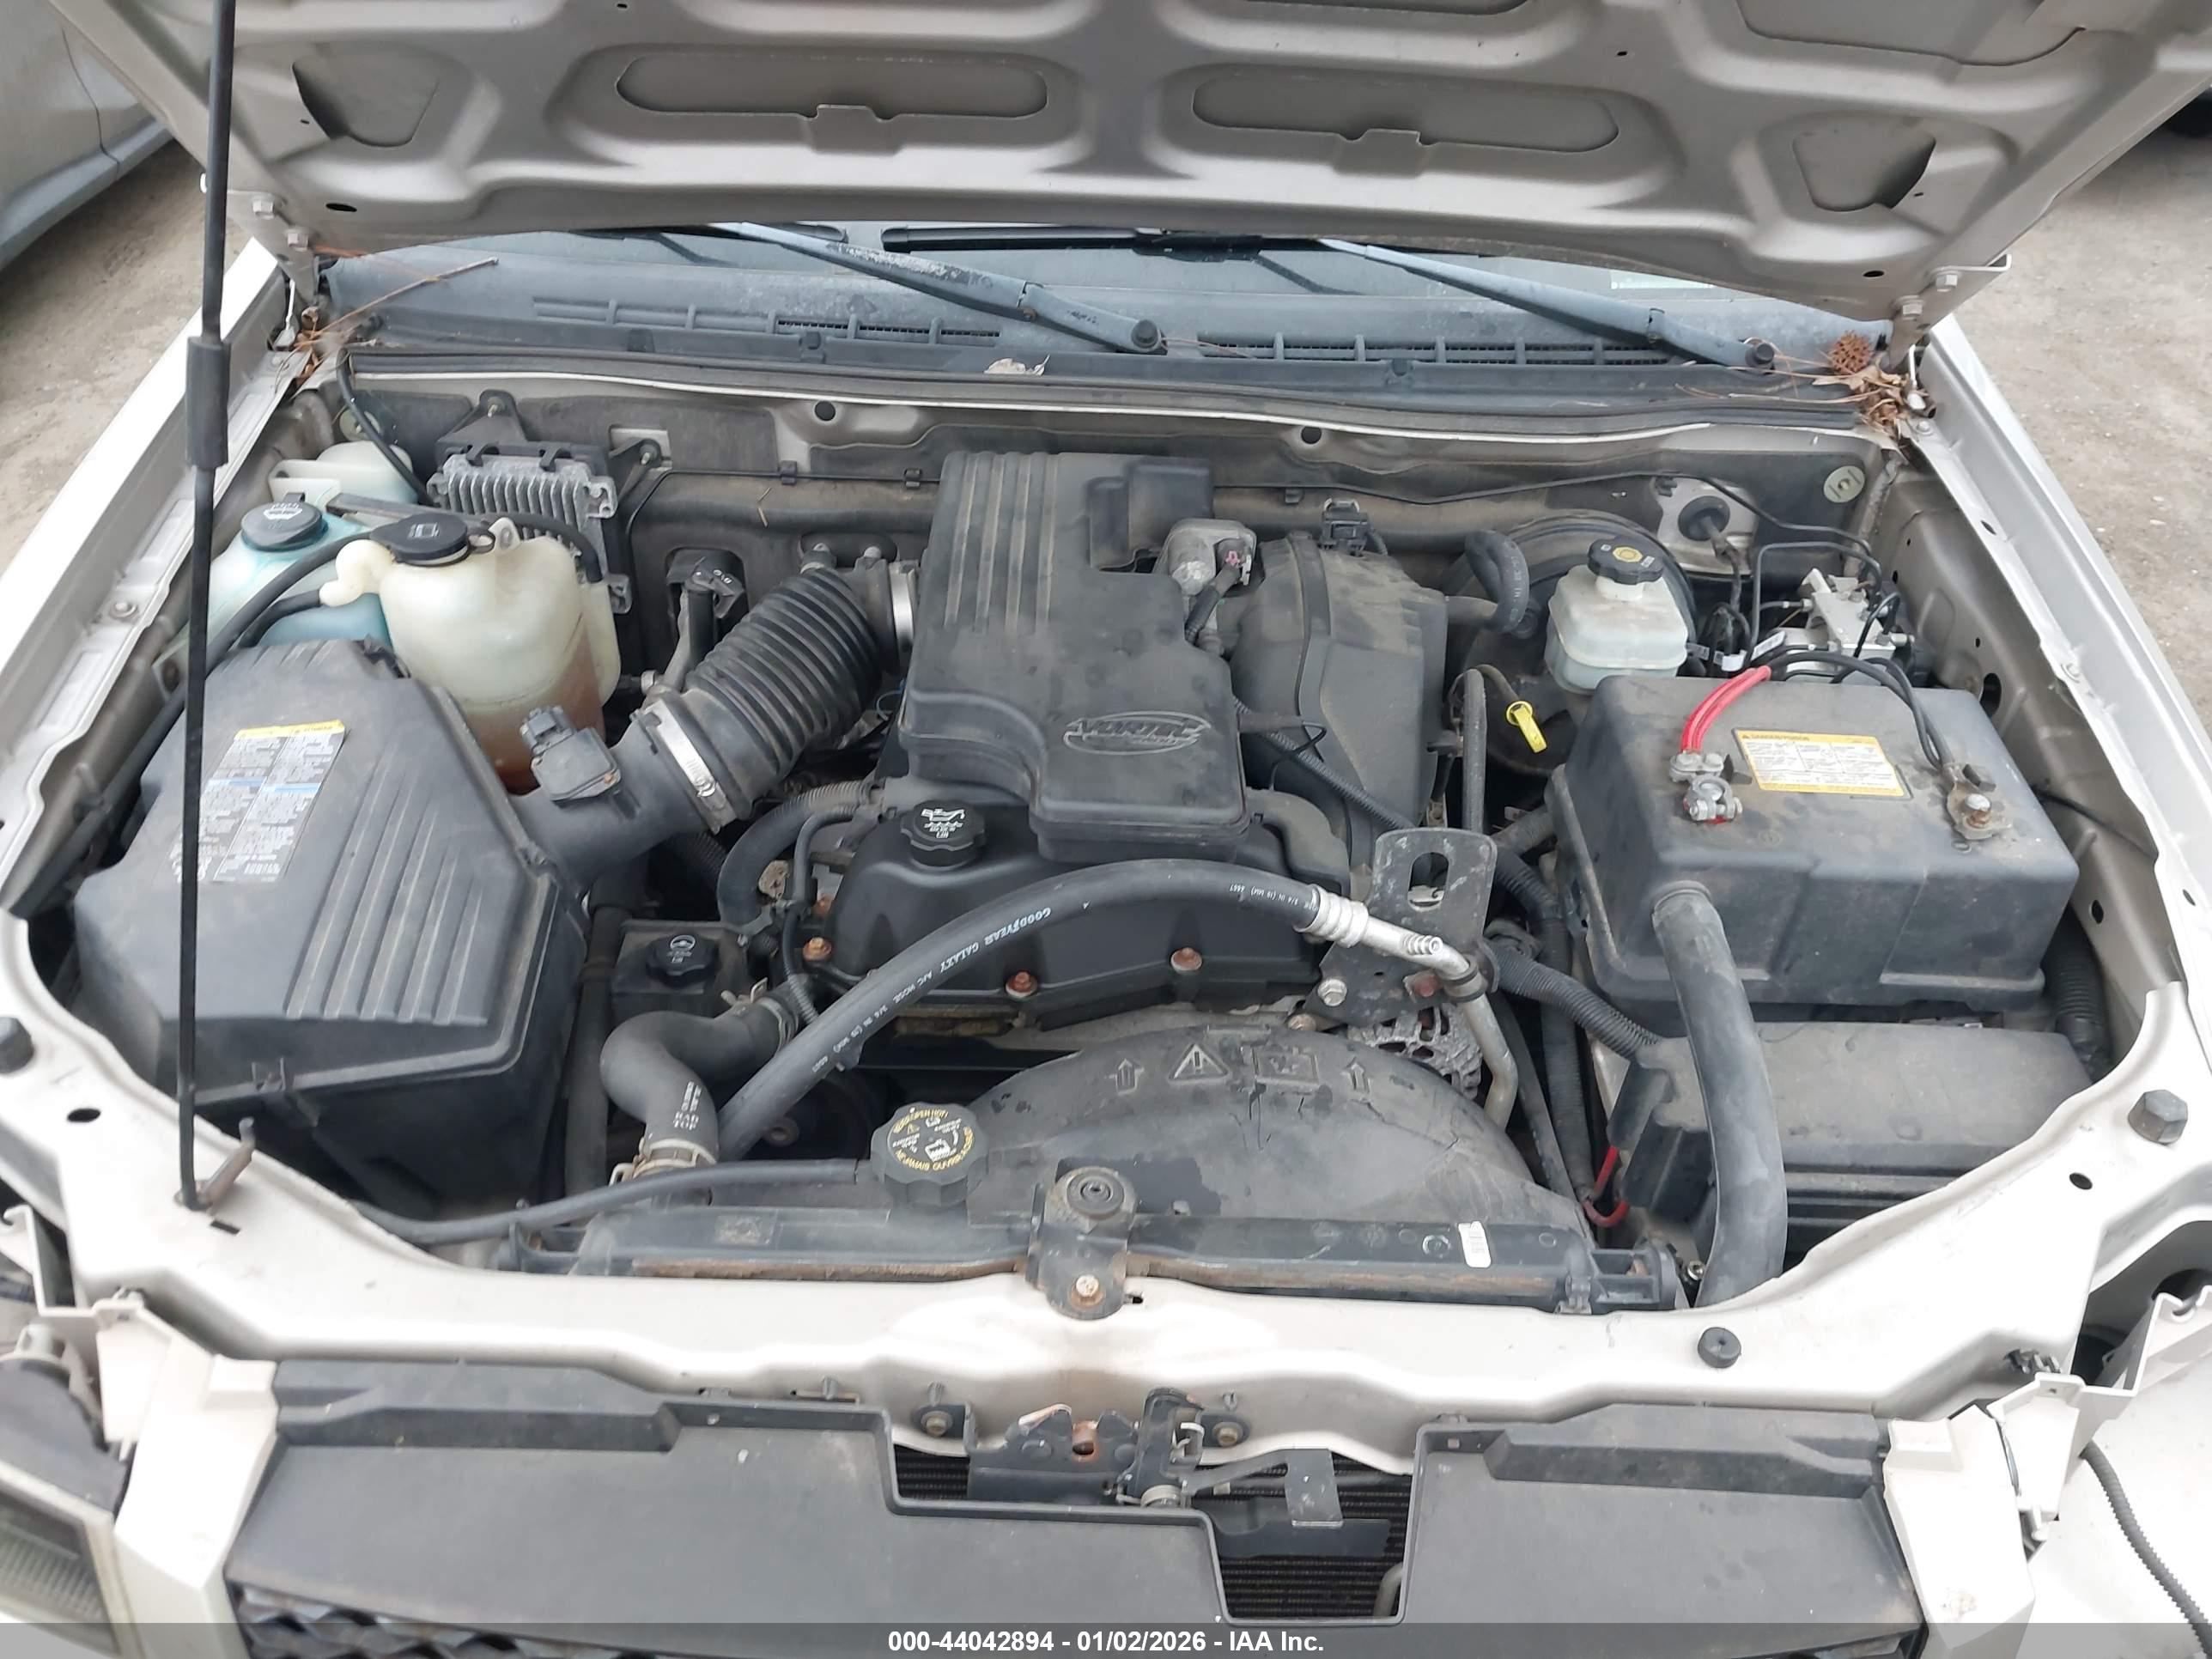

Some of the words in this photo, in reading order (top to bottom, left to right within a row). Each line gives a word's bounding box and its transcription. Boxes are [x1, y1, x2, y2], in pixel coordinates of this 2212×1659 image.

[984, 907, 1053, 945] GOODYEAR
[939, 941, 980, 973] GALAXY
[915, 969, 933, 986] A/C
[892, 983, 916, 1004] HOSE
